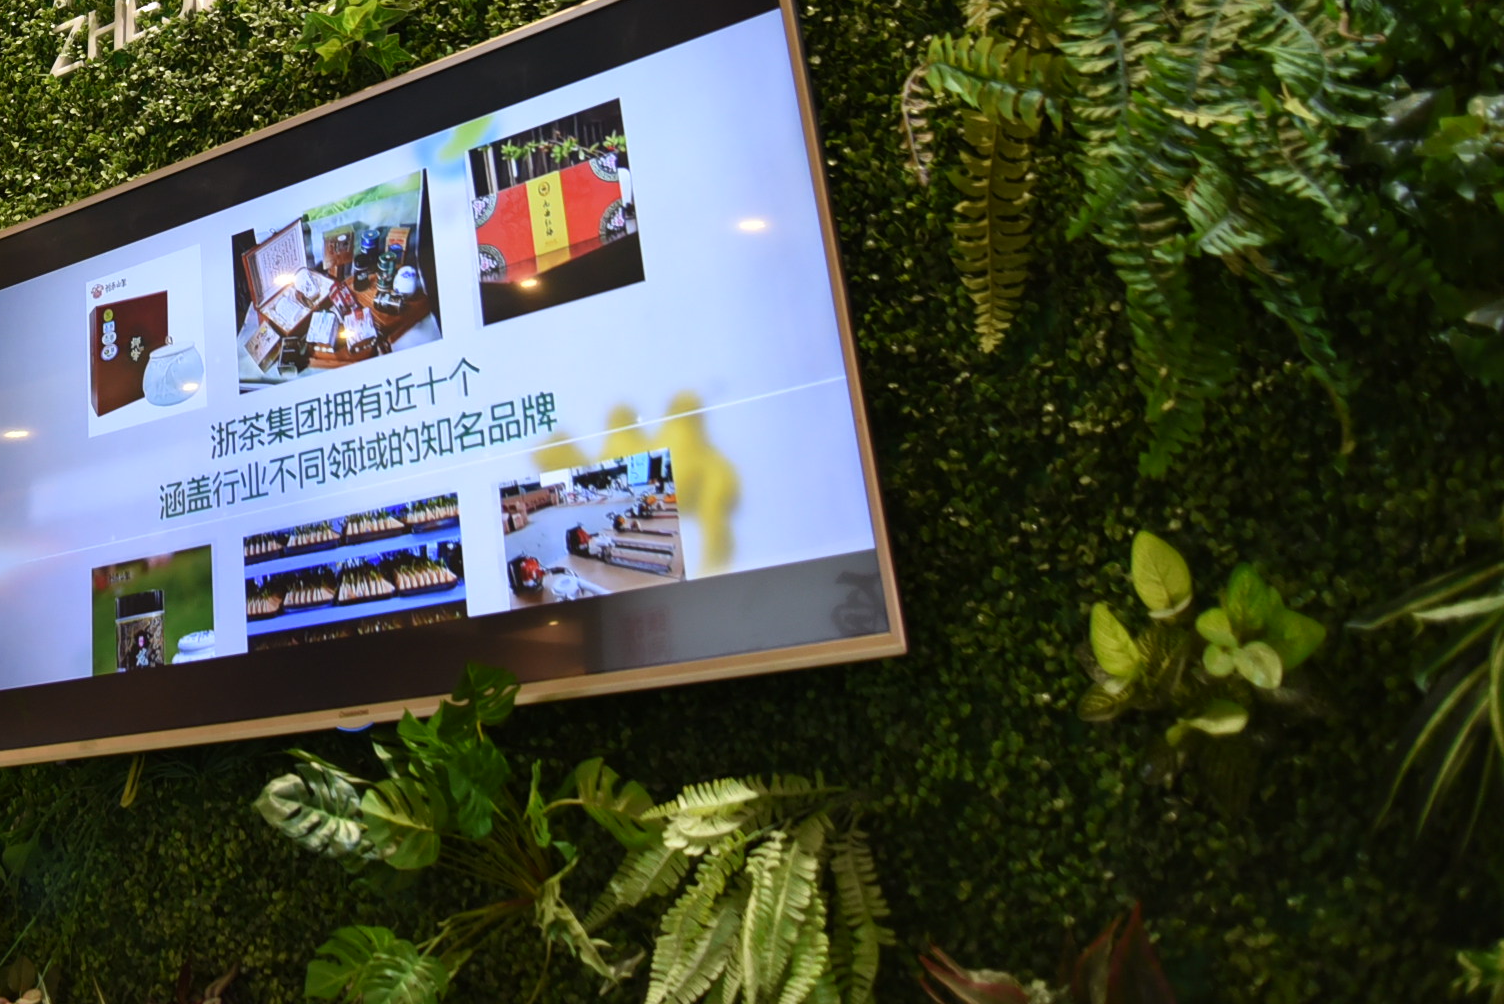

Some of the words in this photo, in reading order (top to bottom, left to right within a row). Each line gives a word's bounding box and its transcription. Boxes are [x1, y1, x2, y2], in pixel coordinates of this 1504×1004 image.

[158, 391, 559, 521] 涵盖行业不同领域的知名品牌
[210, 356, 481, 460] 浙茶集团拥有近十个
